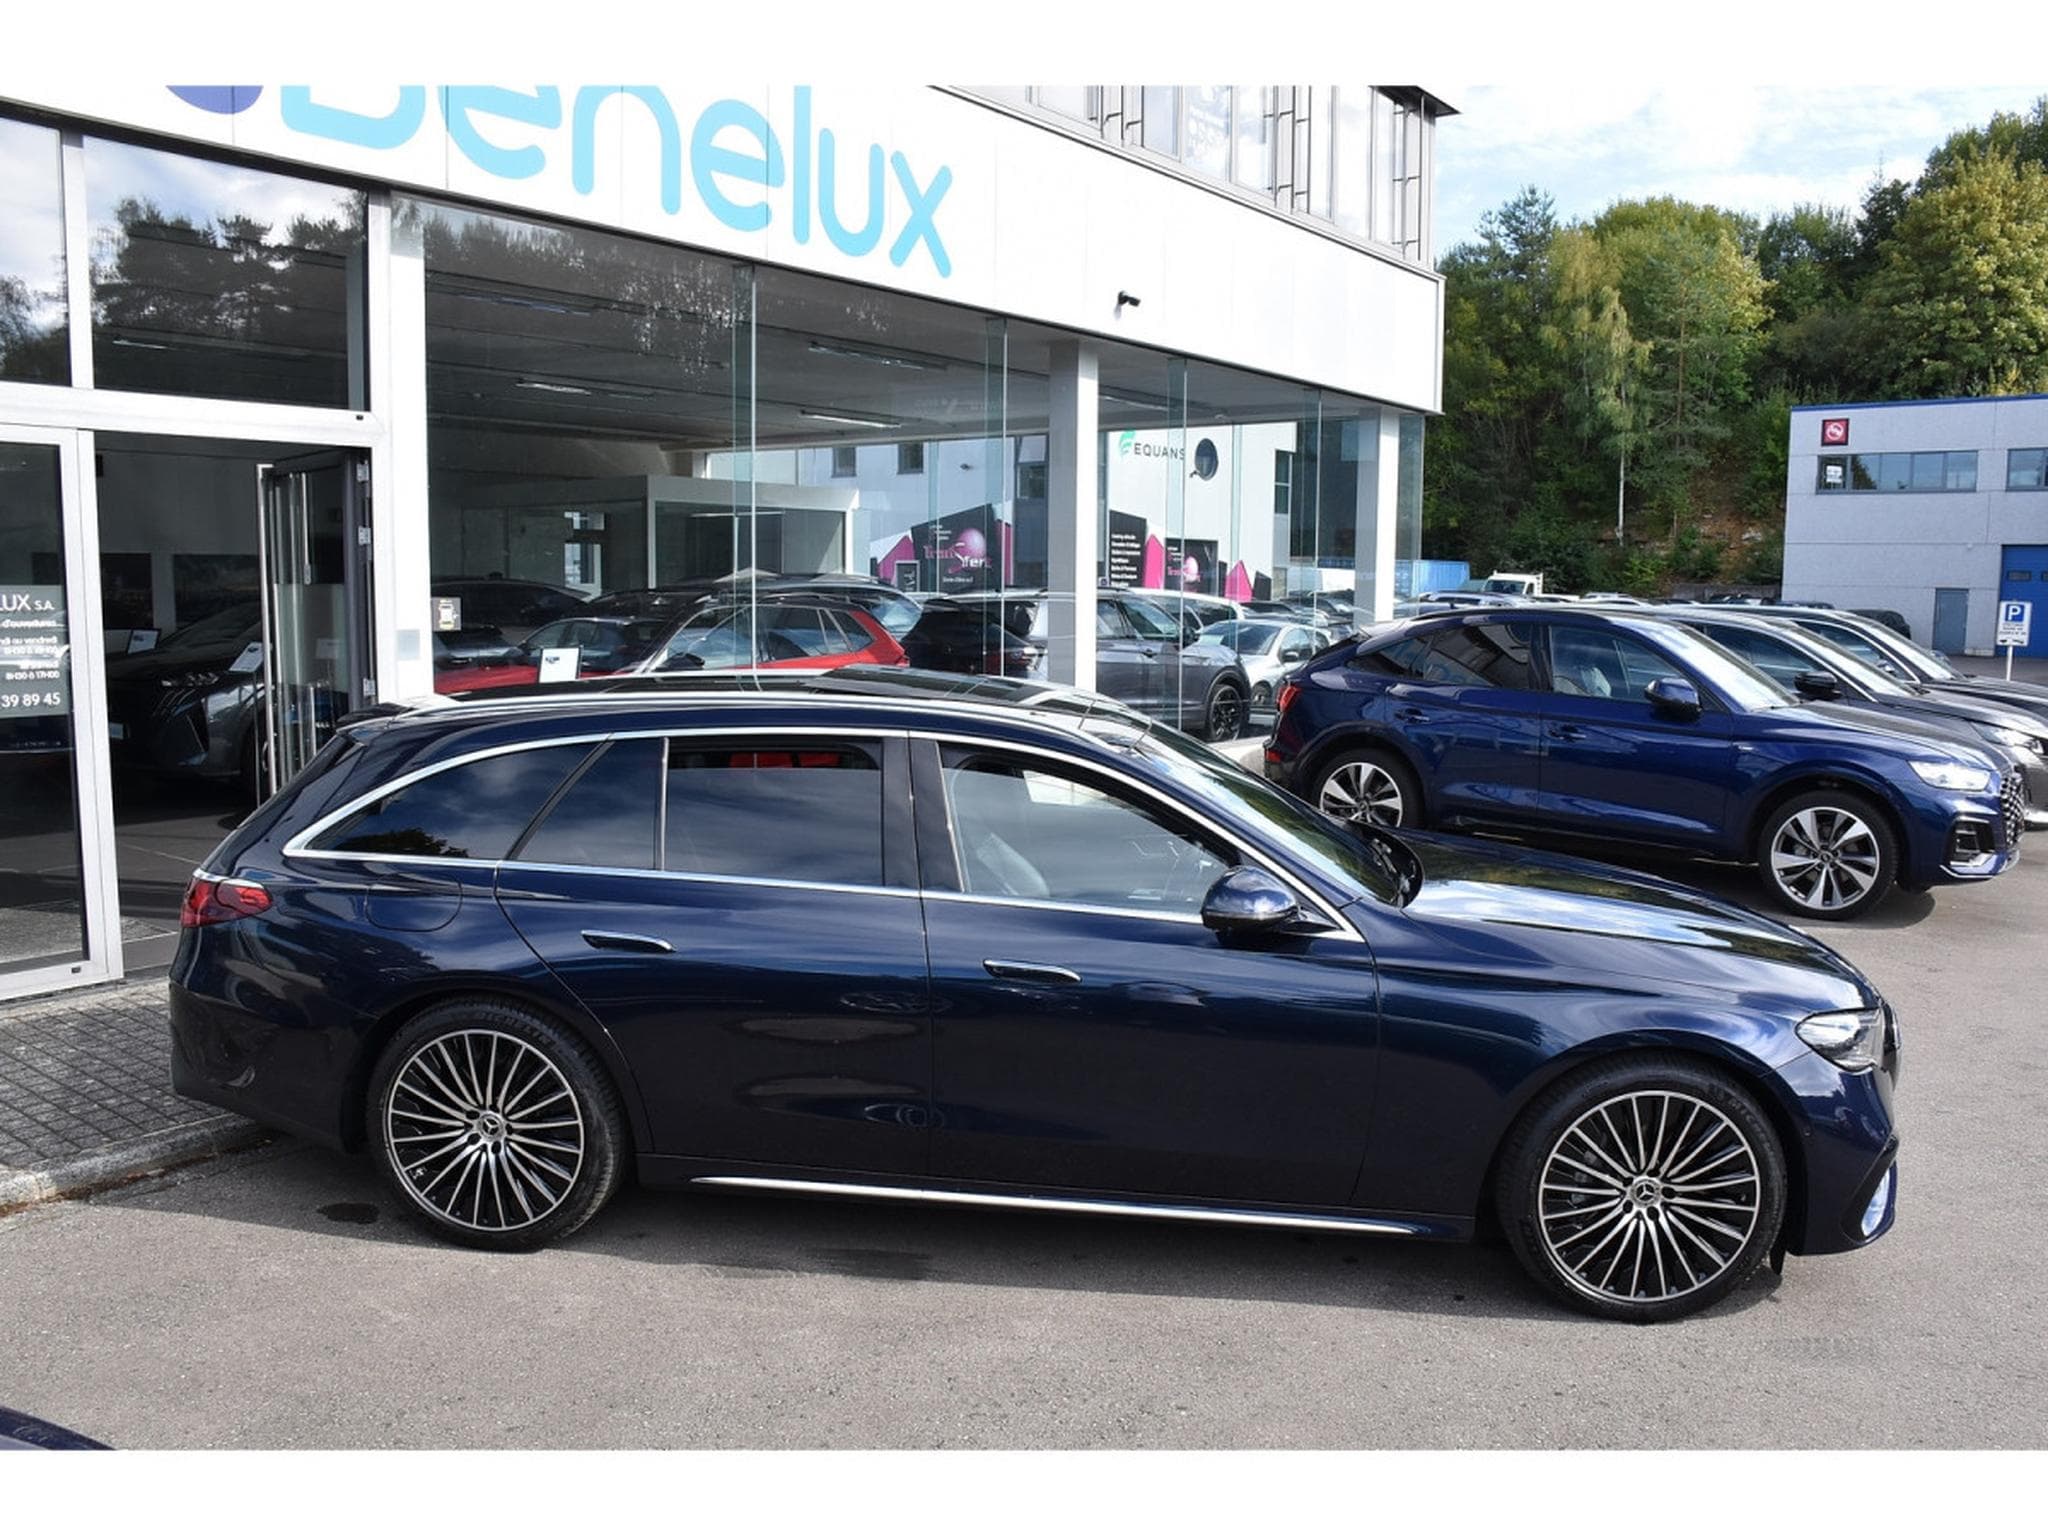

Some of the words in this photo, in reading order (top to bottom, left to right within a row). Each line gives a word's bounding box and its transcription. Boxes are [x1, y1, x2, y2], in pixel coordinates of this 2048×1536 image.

[1134, 443, 1186, 461] EQUANS
[0, 594, 31, 611] UX
[2008, 605, 2021, 621] P
[1, 694, 19, 707] 39
[22, 693, 41, 707] 89
[43, 692, 61, 705] 45
